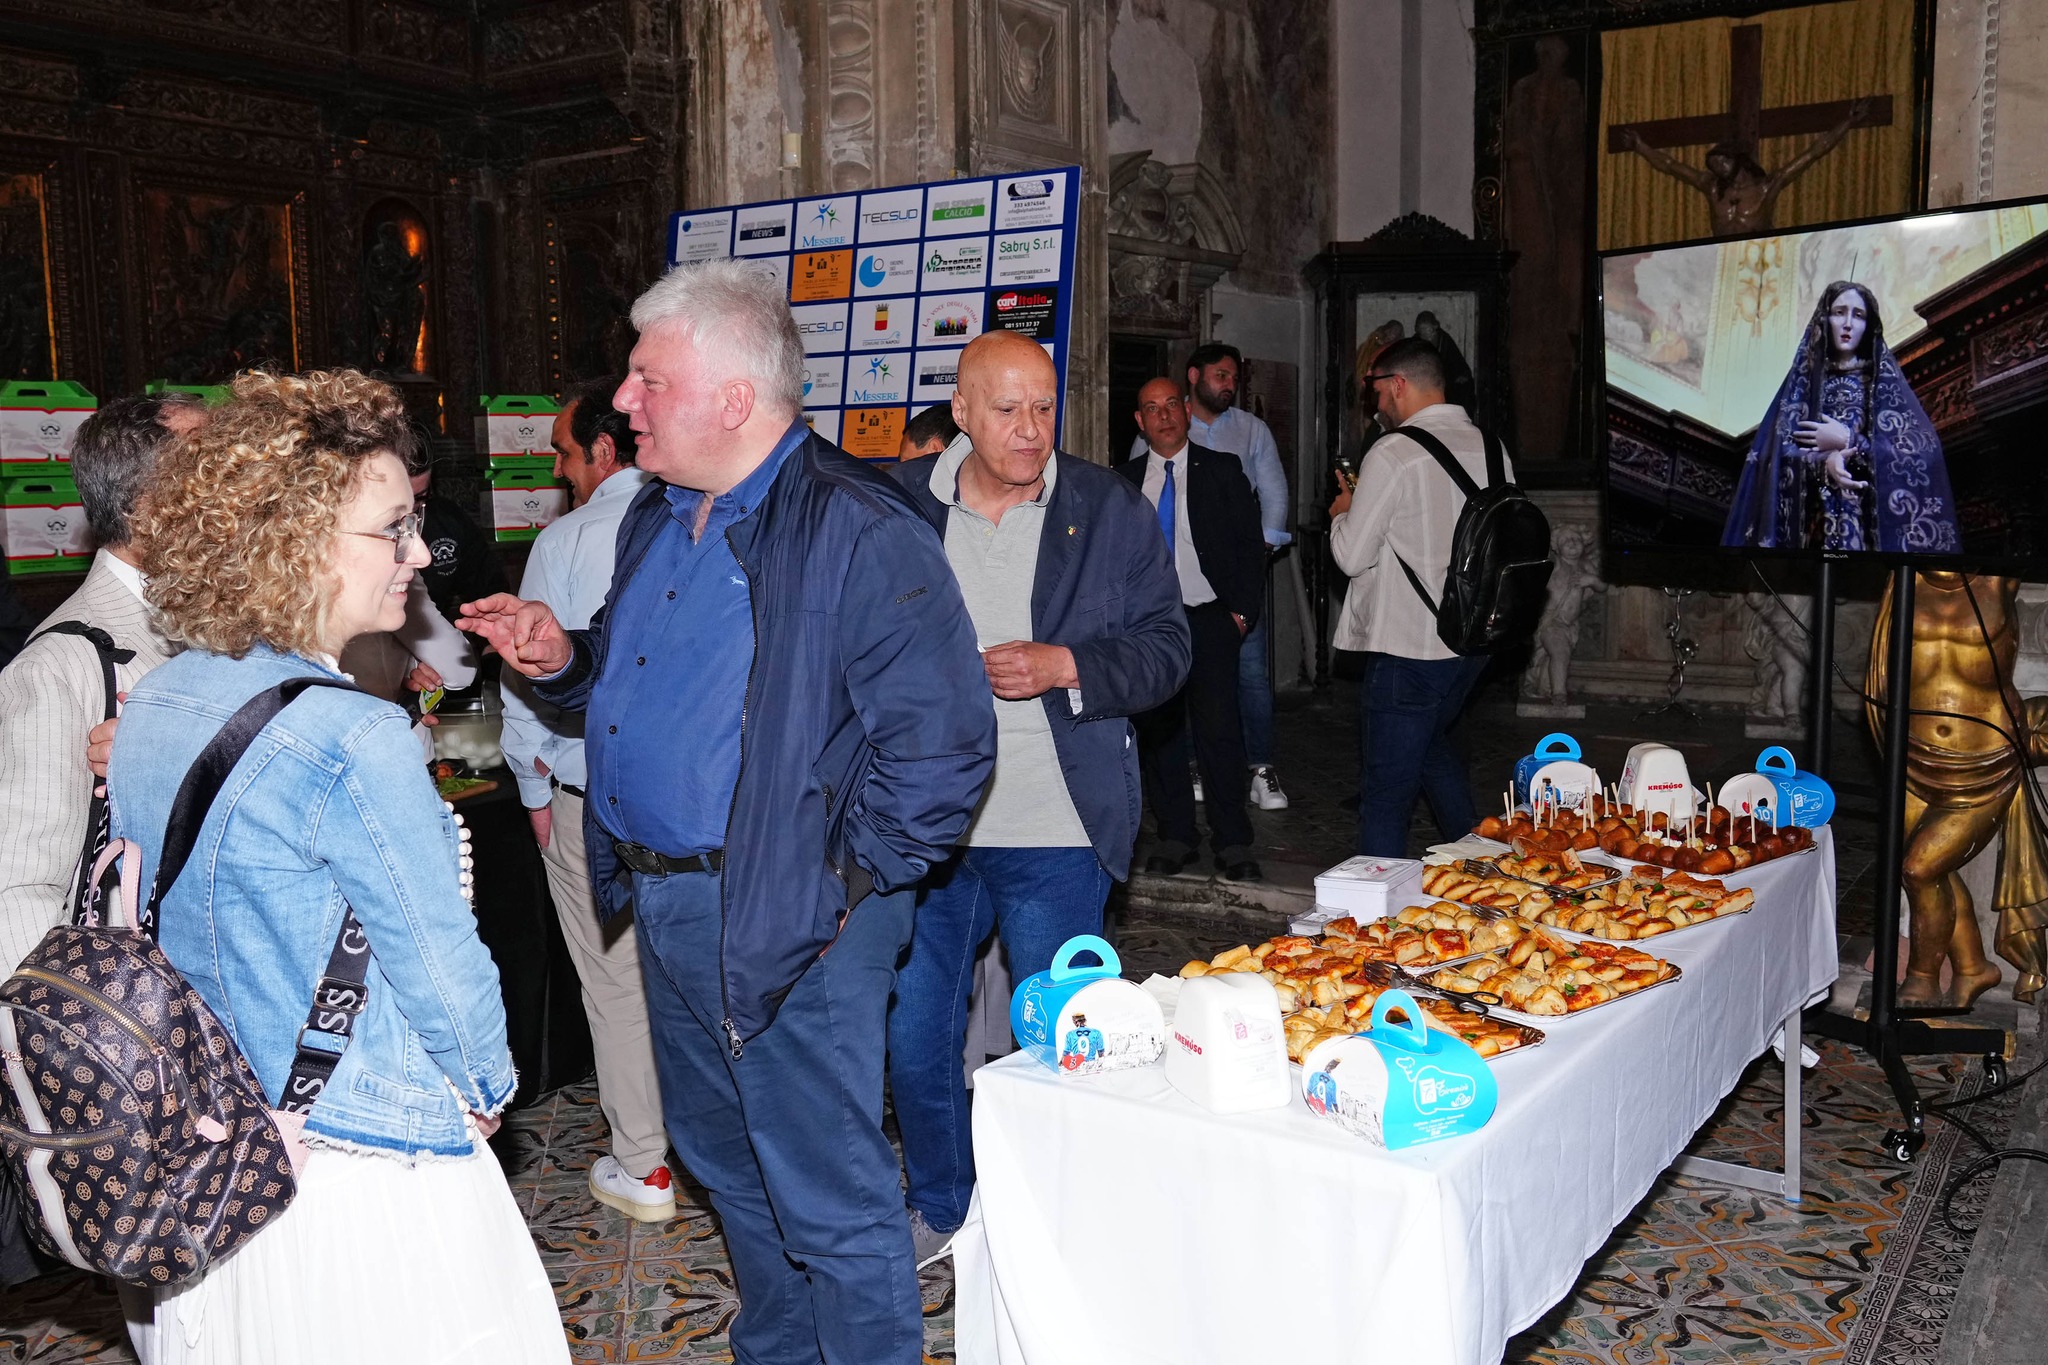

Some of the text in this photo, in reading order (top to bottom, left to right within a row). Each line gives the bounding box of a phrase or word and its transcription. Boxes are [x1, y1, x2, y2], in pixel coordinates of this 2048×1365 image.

[863, 209, 918, 223] TECSUD
[944, 208, 973, 218] CALCIO
[752, 229, 774, 238] NEWS
[1000, 237, 1055, 253] Sabry S.r.l.
[800, 321, 844, 333] ECSUD
[896, 586, 928, 604] GEOX
[1758, 809, 1770, 820] 10
[1077, 1035, 1090, 1054] 9
